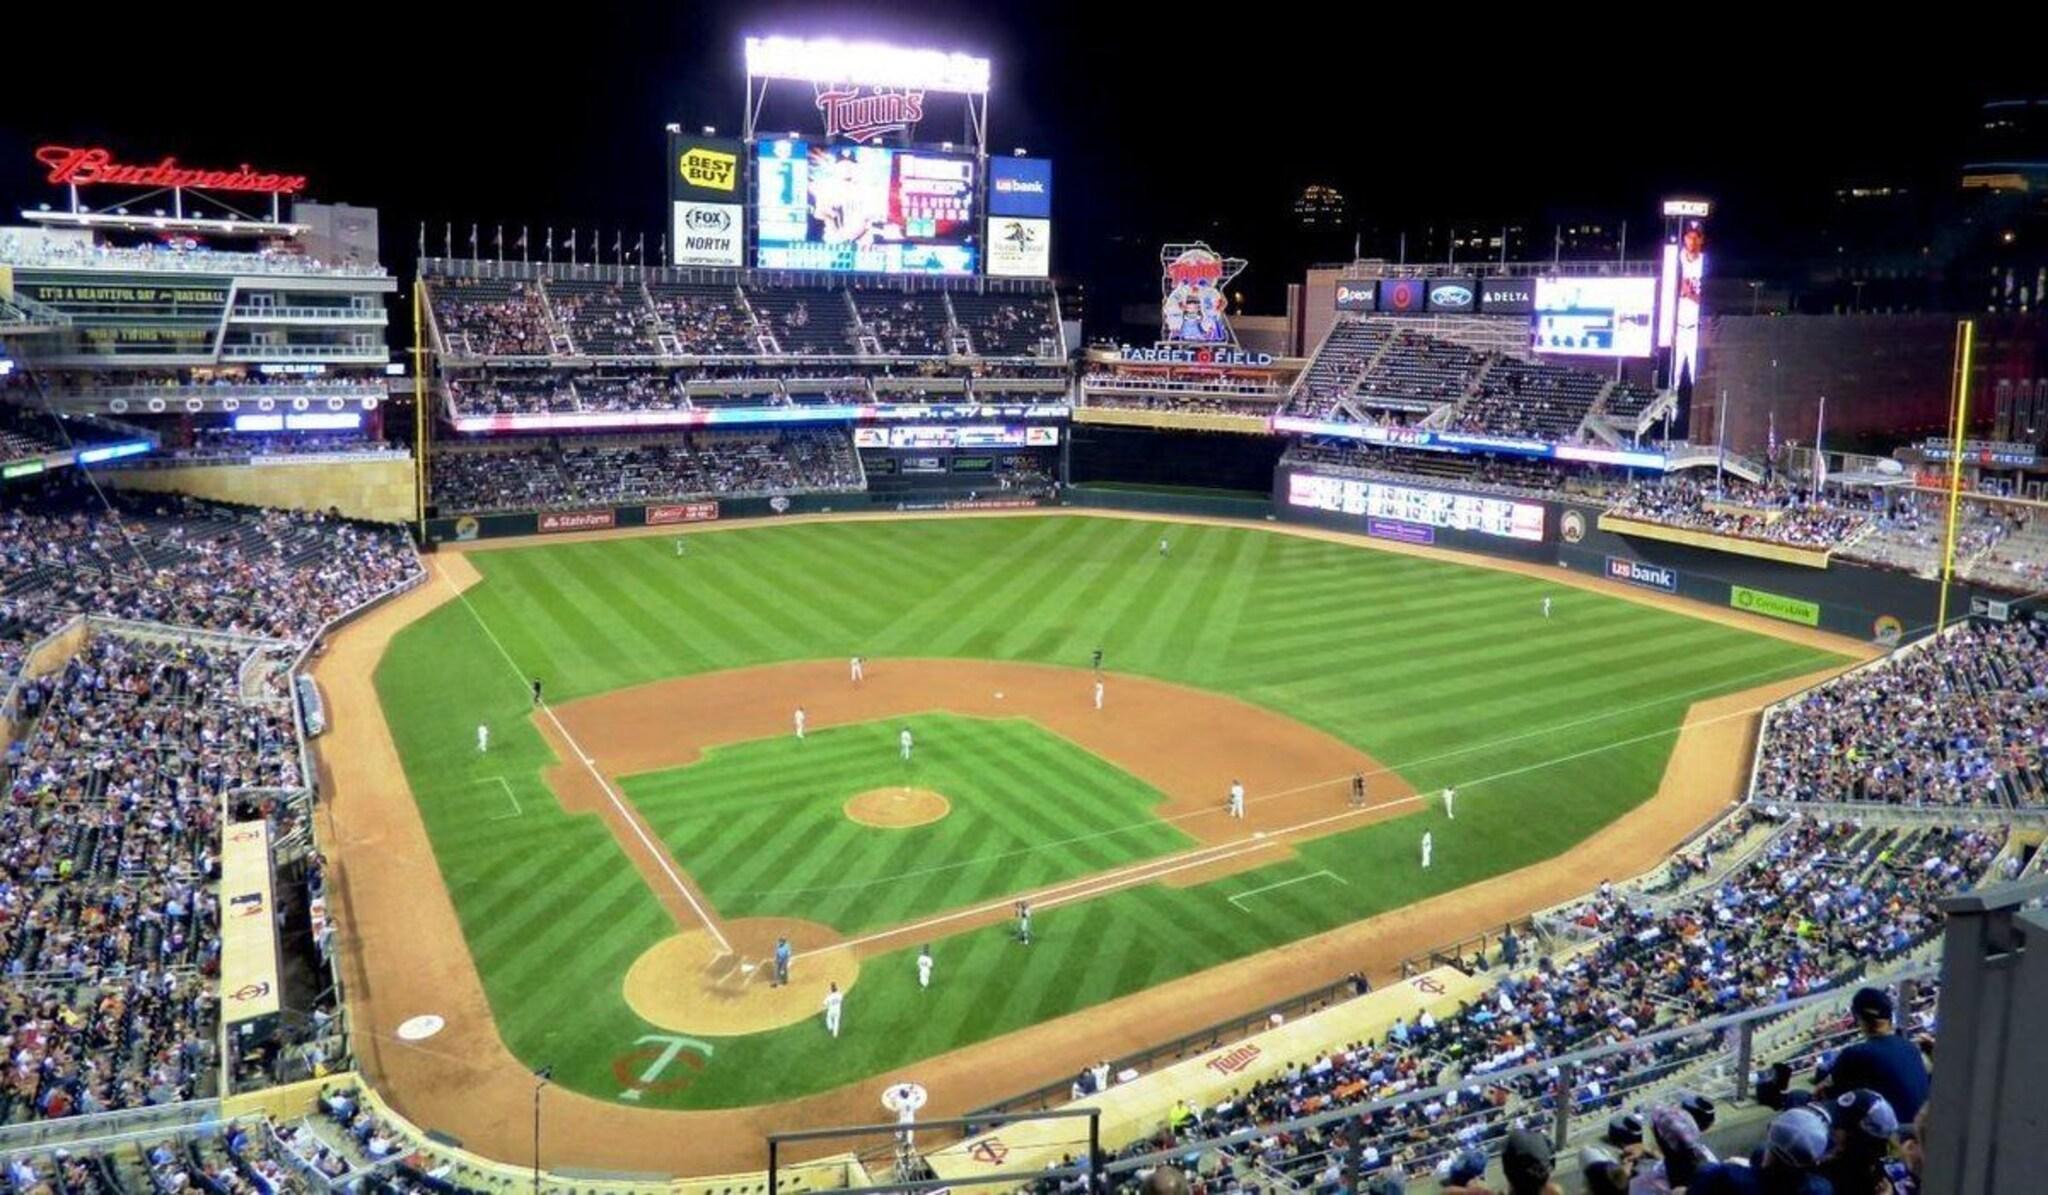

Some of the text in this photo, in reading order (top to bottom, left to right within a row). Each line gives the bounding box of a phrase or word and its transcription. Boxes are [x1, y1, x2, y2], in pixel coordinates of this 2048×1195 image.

[816, 86, 923, 141] Twins
[36, 146, 305, 193] Budweiser
[688, 155, 734, 172] BEST
[689, 168, 728, 183] BUY
[694, 211, 721, 224] FOX
[685, 236, 731, 251] NORTH
[1349, 289, 1373, 303] pepsi
[1438, 292, 1463, 305] Ford
[1494, 292, 1529, 302] DELTA
[1121, 347, 1272, 365] TARGET FIELD
[1206, 1042, 1262, 1075] Twins
